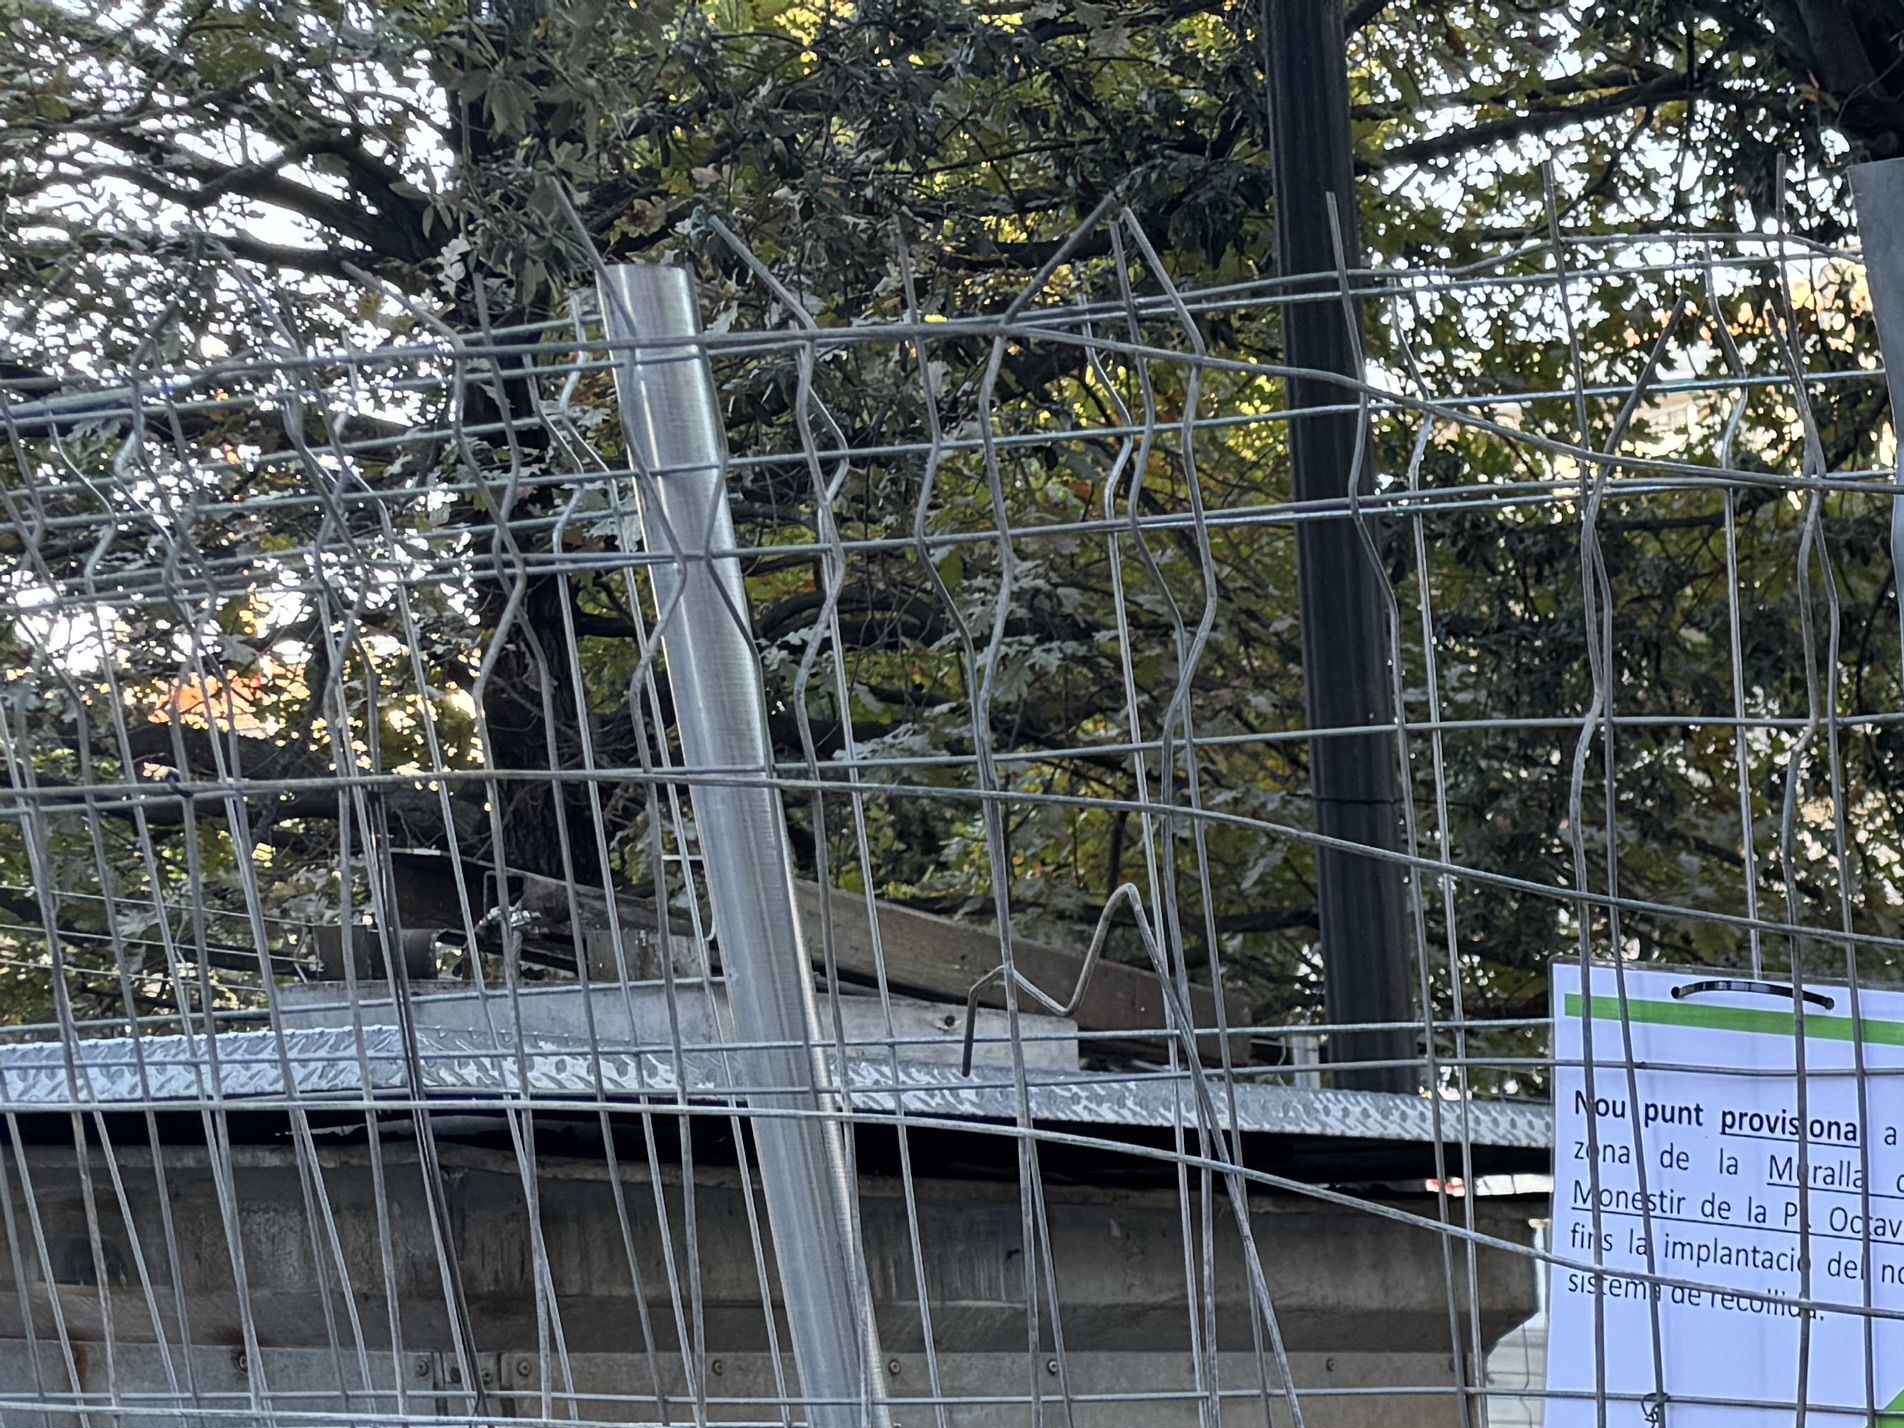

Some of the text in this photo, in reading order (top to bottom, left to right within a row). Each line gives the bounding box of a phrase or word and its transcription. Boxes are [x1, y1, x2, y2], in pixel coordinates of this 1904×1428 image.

[1644, 1102, 1704, 1128] punt
[1721, 1109, 1860, 1143] provisona
[1884, 1126, 1897, 1146] a
[1574, 1141, 1630, 1165] zna
[1660, 1142, 1689, 1171] de
[1719, 1147, 1738, 1176] la
[1769, 1154, 1865, 1190] Mralla
[1573, 1179, 1686, 1215] Monestir
[1701, 1192, 1731, 1220] de
[1747, 1196, 1766, 1224] la
[1784, 1201, 1811, 1229] P.
[1629, 1228, 1648, 1256] la
[1664, 1233, 1811, 1272] implantaci
[1828, 1251, 1865, 1280] del
